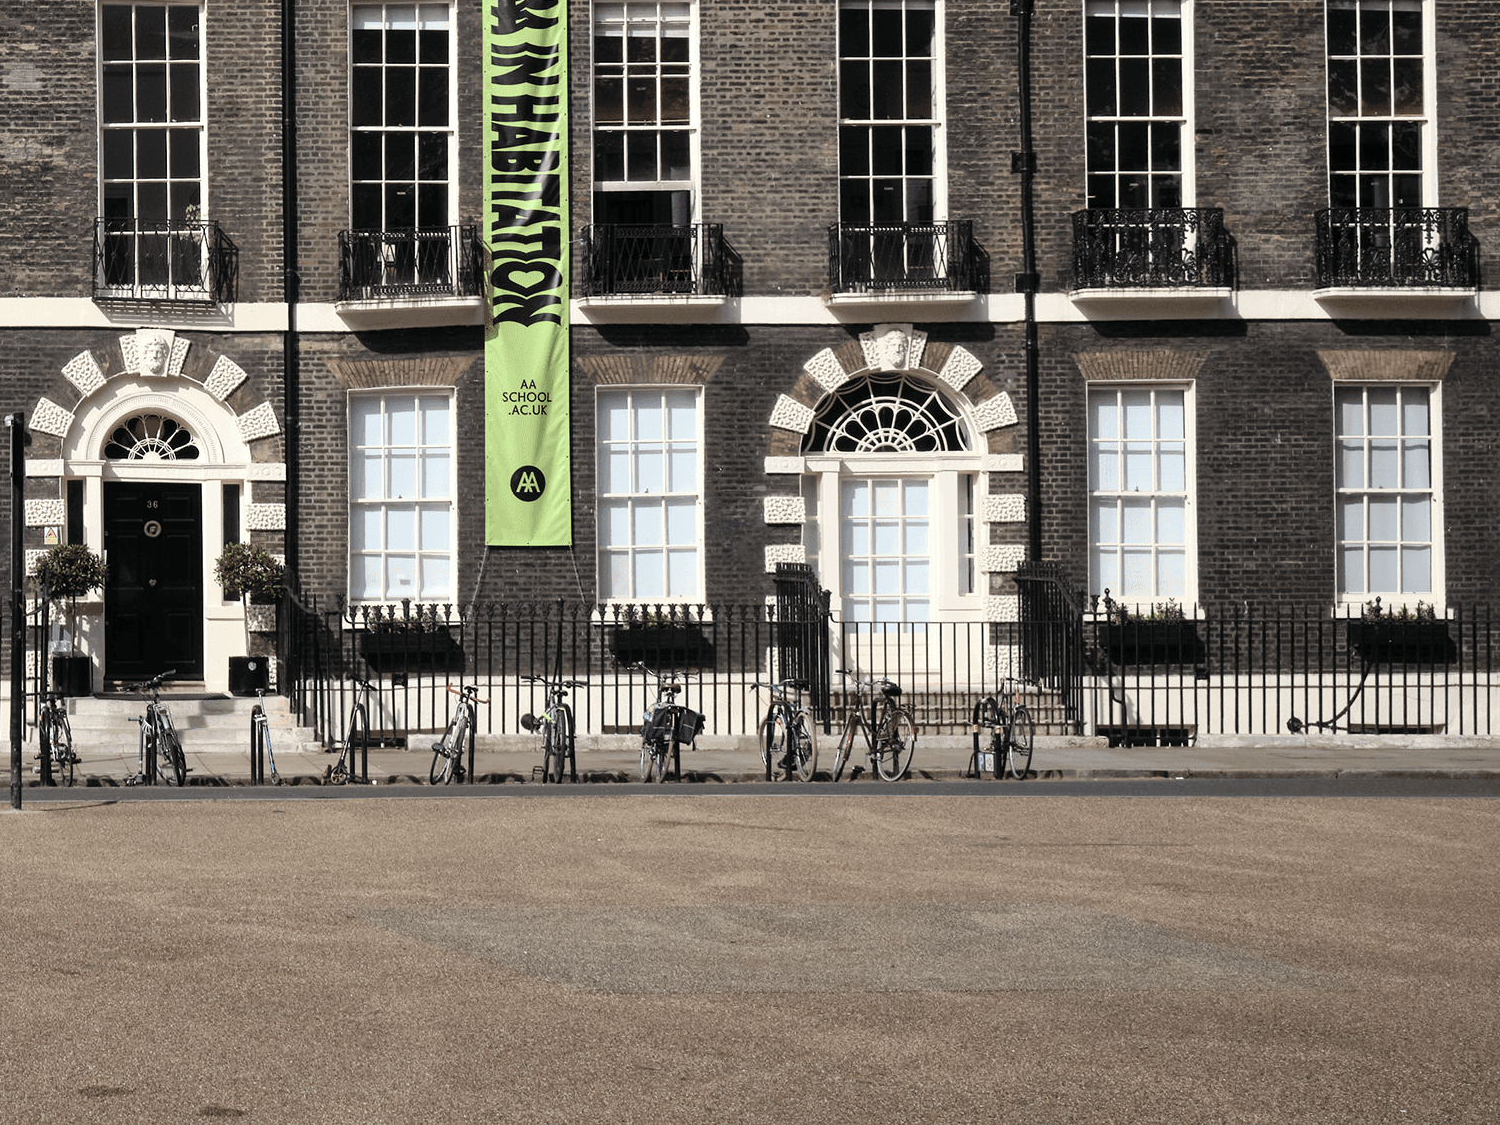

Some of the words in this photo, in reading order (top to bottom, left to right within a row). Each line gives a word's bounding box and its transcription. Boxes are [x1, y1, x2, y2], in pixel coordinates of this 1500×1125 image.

[520, 379, 537, 389] AA
[502, 392, 552, 402] SCHOOL
[508, 405, 548, 415] .AC.UK
[516, 471, 541, 493] AA
[146, 500, 159, 509] 36
